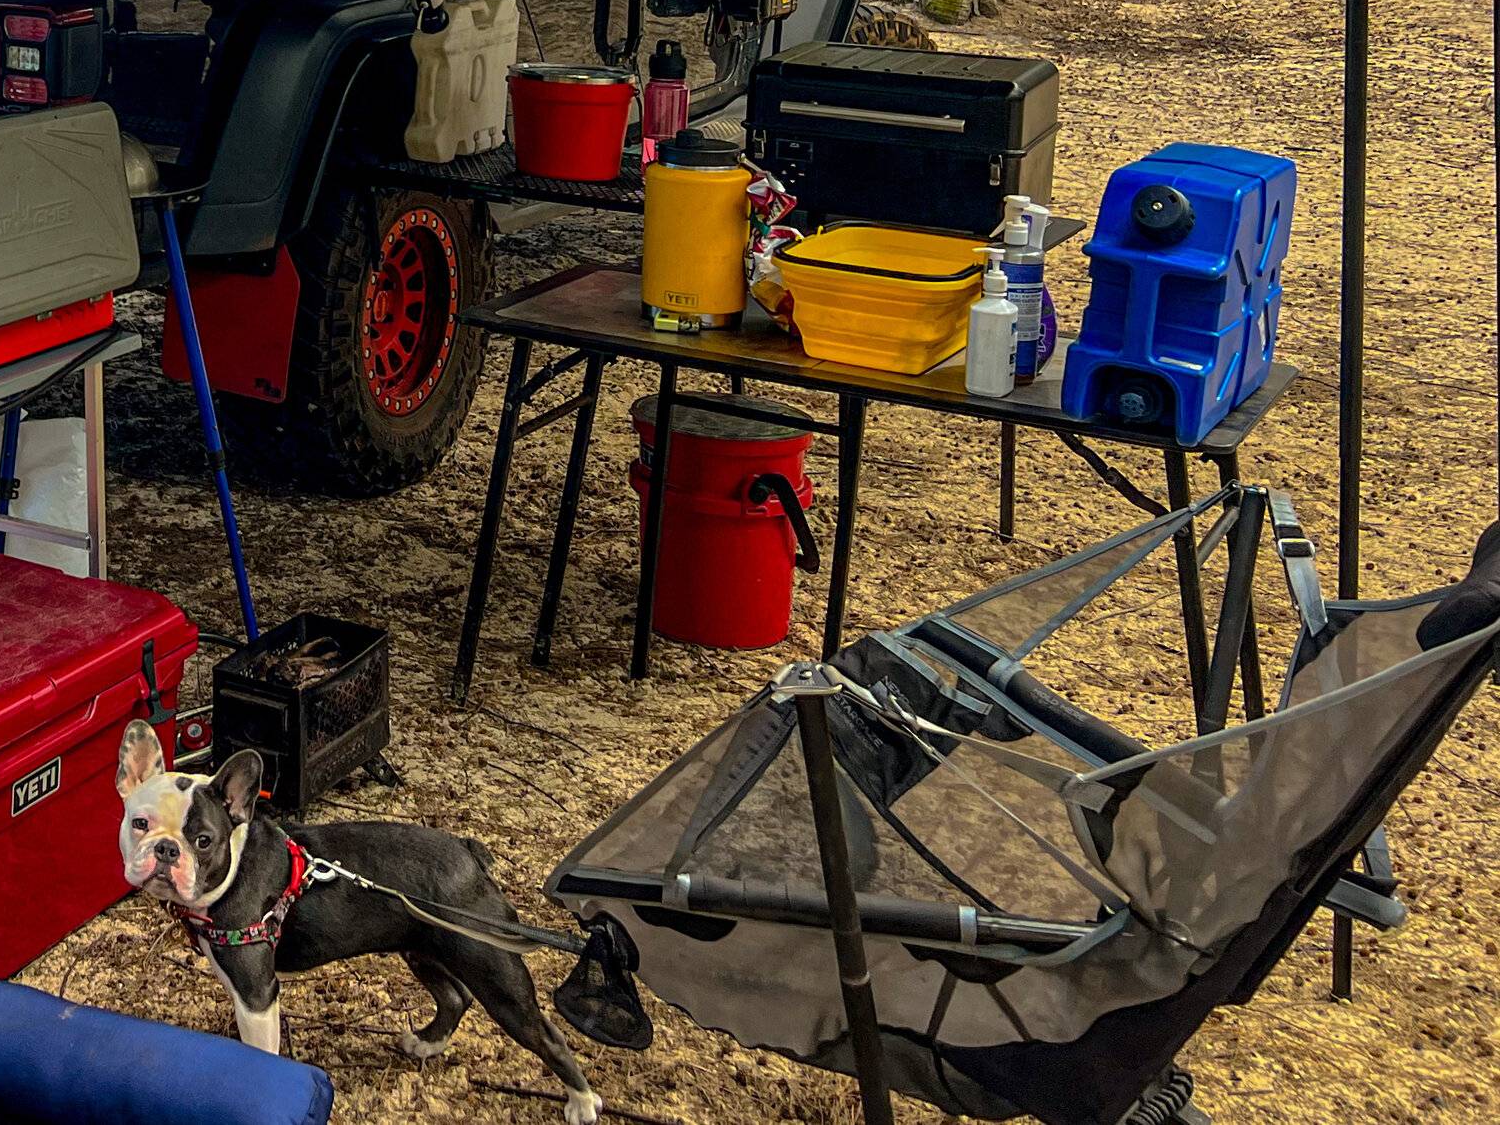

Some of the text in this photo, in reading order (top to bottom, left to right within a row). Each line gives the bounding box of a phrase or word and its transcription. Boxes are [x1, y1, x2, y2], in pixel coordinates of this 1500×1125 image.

[667, 293, 696, 306] YETI
[832, 692, 885, 749] STARGAZE
[15, 766, 57, 807] YETI
